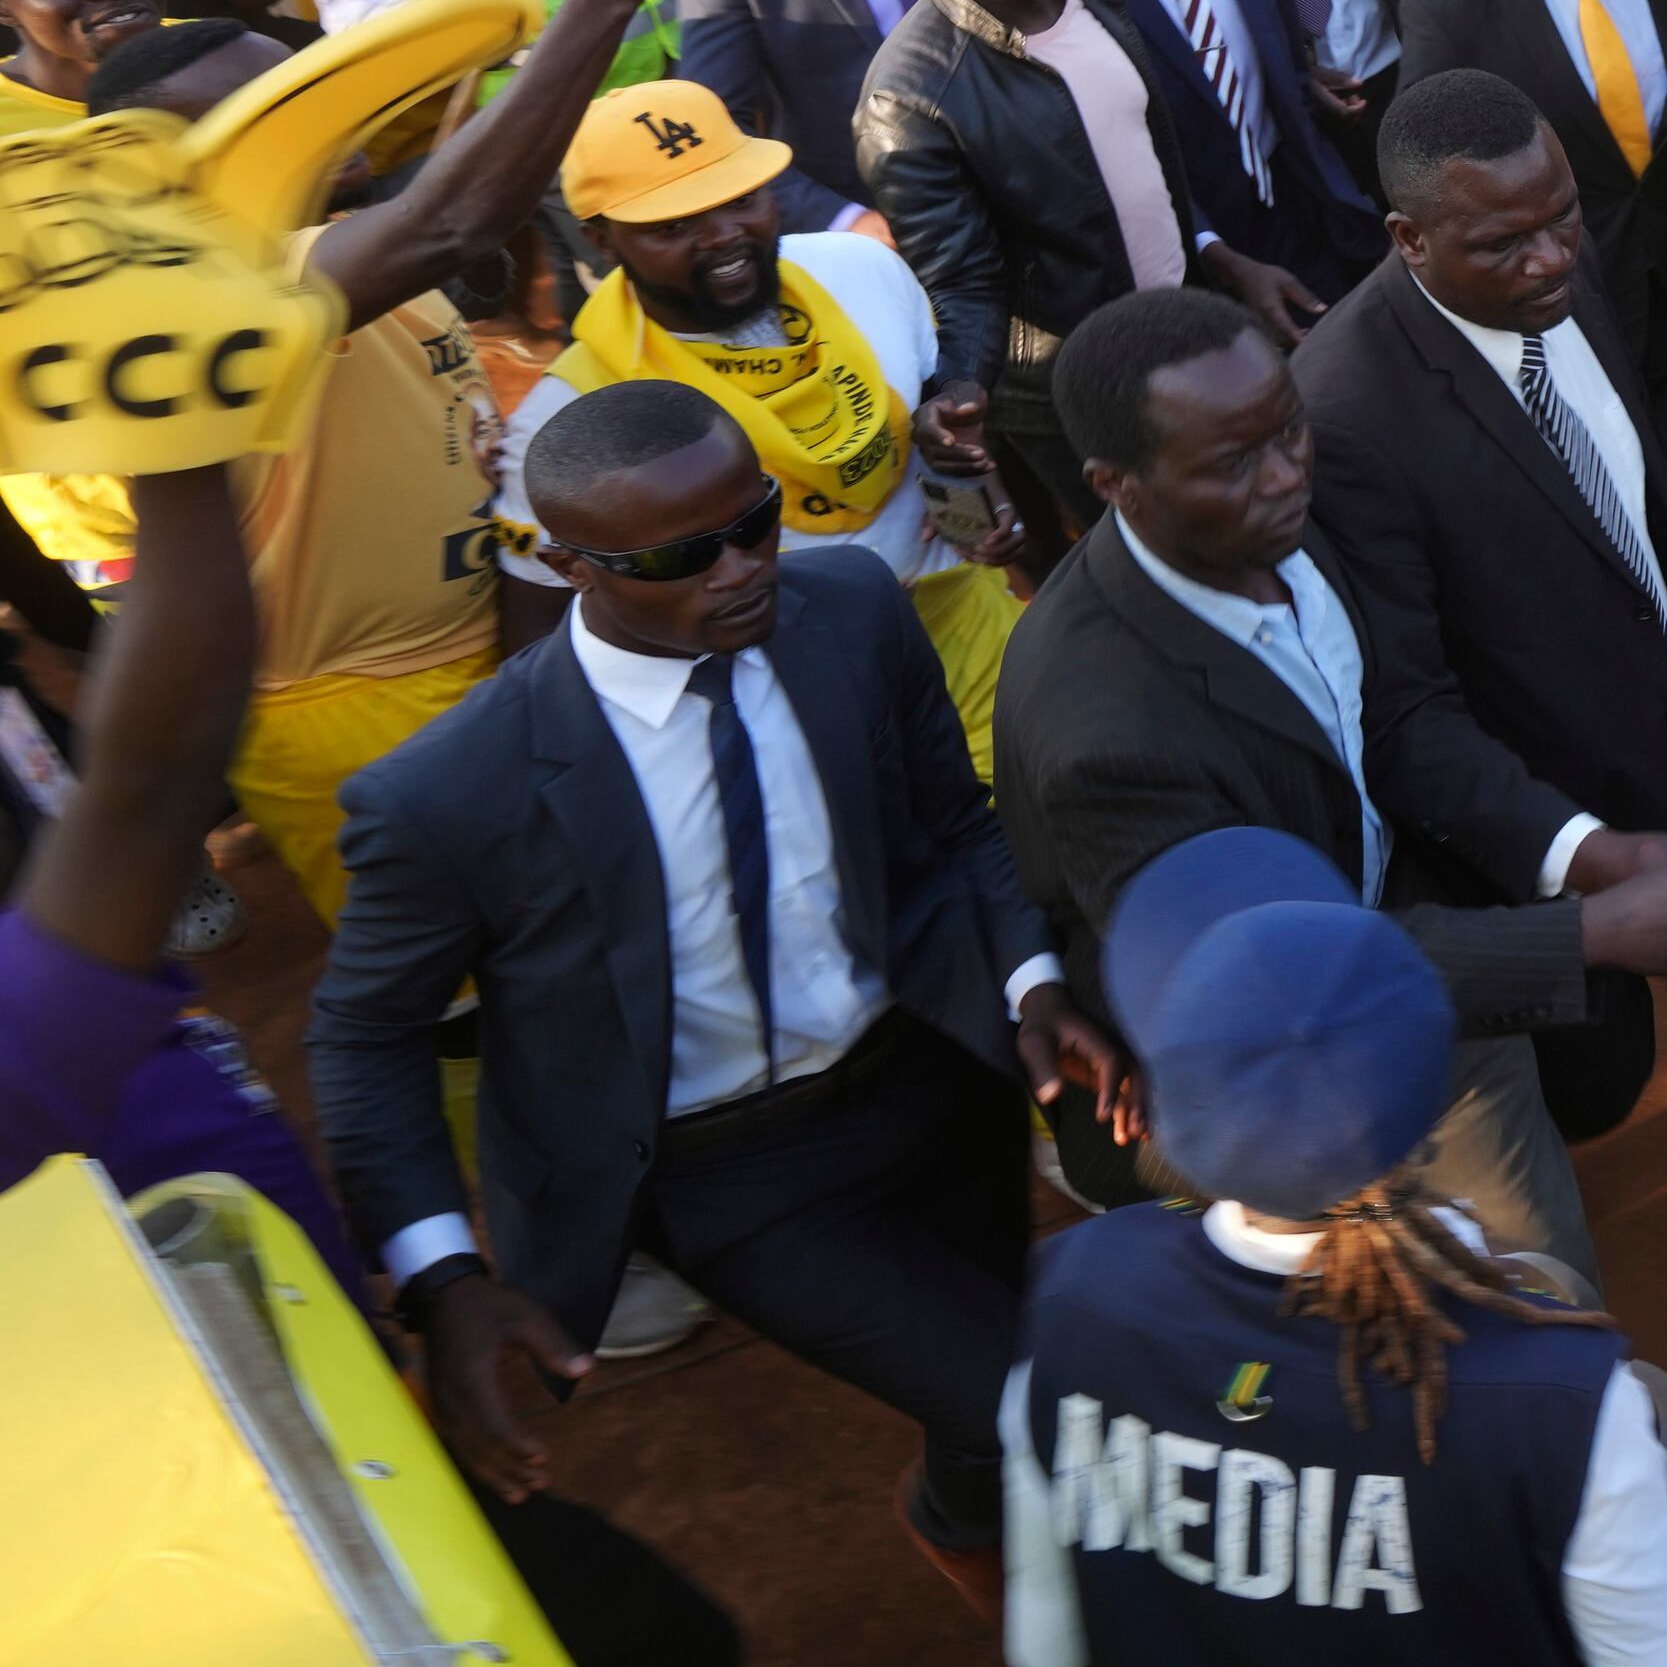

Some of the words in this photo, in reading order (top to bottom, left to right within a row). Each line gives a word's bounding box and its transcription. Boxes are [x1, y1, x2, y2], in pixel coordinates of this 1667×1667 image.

[634, 111, 703, 159] LA
[17, 328, 278, 423] CCC
[1050, 1393, 1423, 1615] MEDIA
